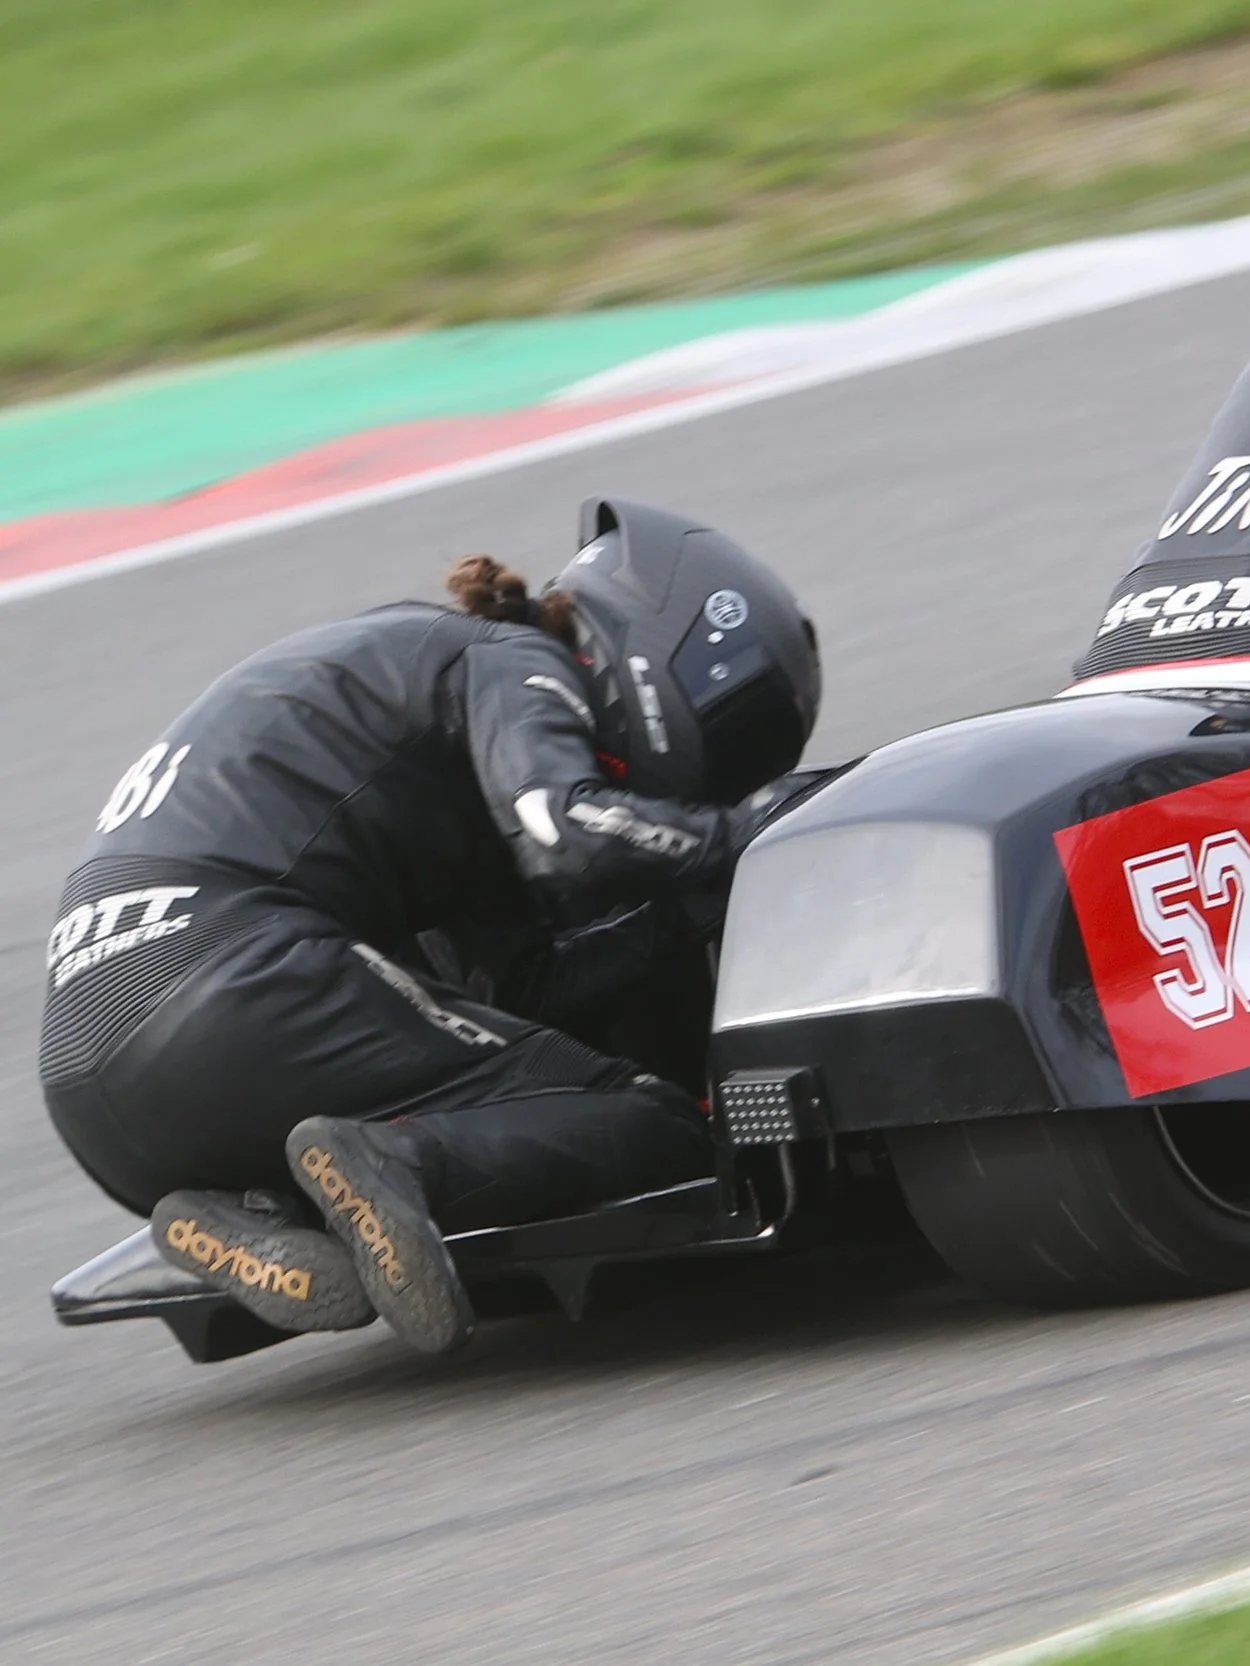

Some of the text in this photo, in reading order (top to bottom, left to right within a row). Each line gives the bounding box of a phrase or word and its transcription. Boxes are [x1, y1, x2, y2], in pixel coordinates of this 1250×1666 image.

[46, 886, 200, 970] COTT
[166, 1218, 312, 1301] daytona
[300, 1145, 413, 1297] daytona
